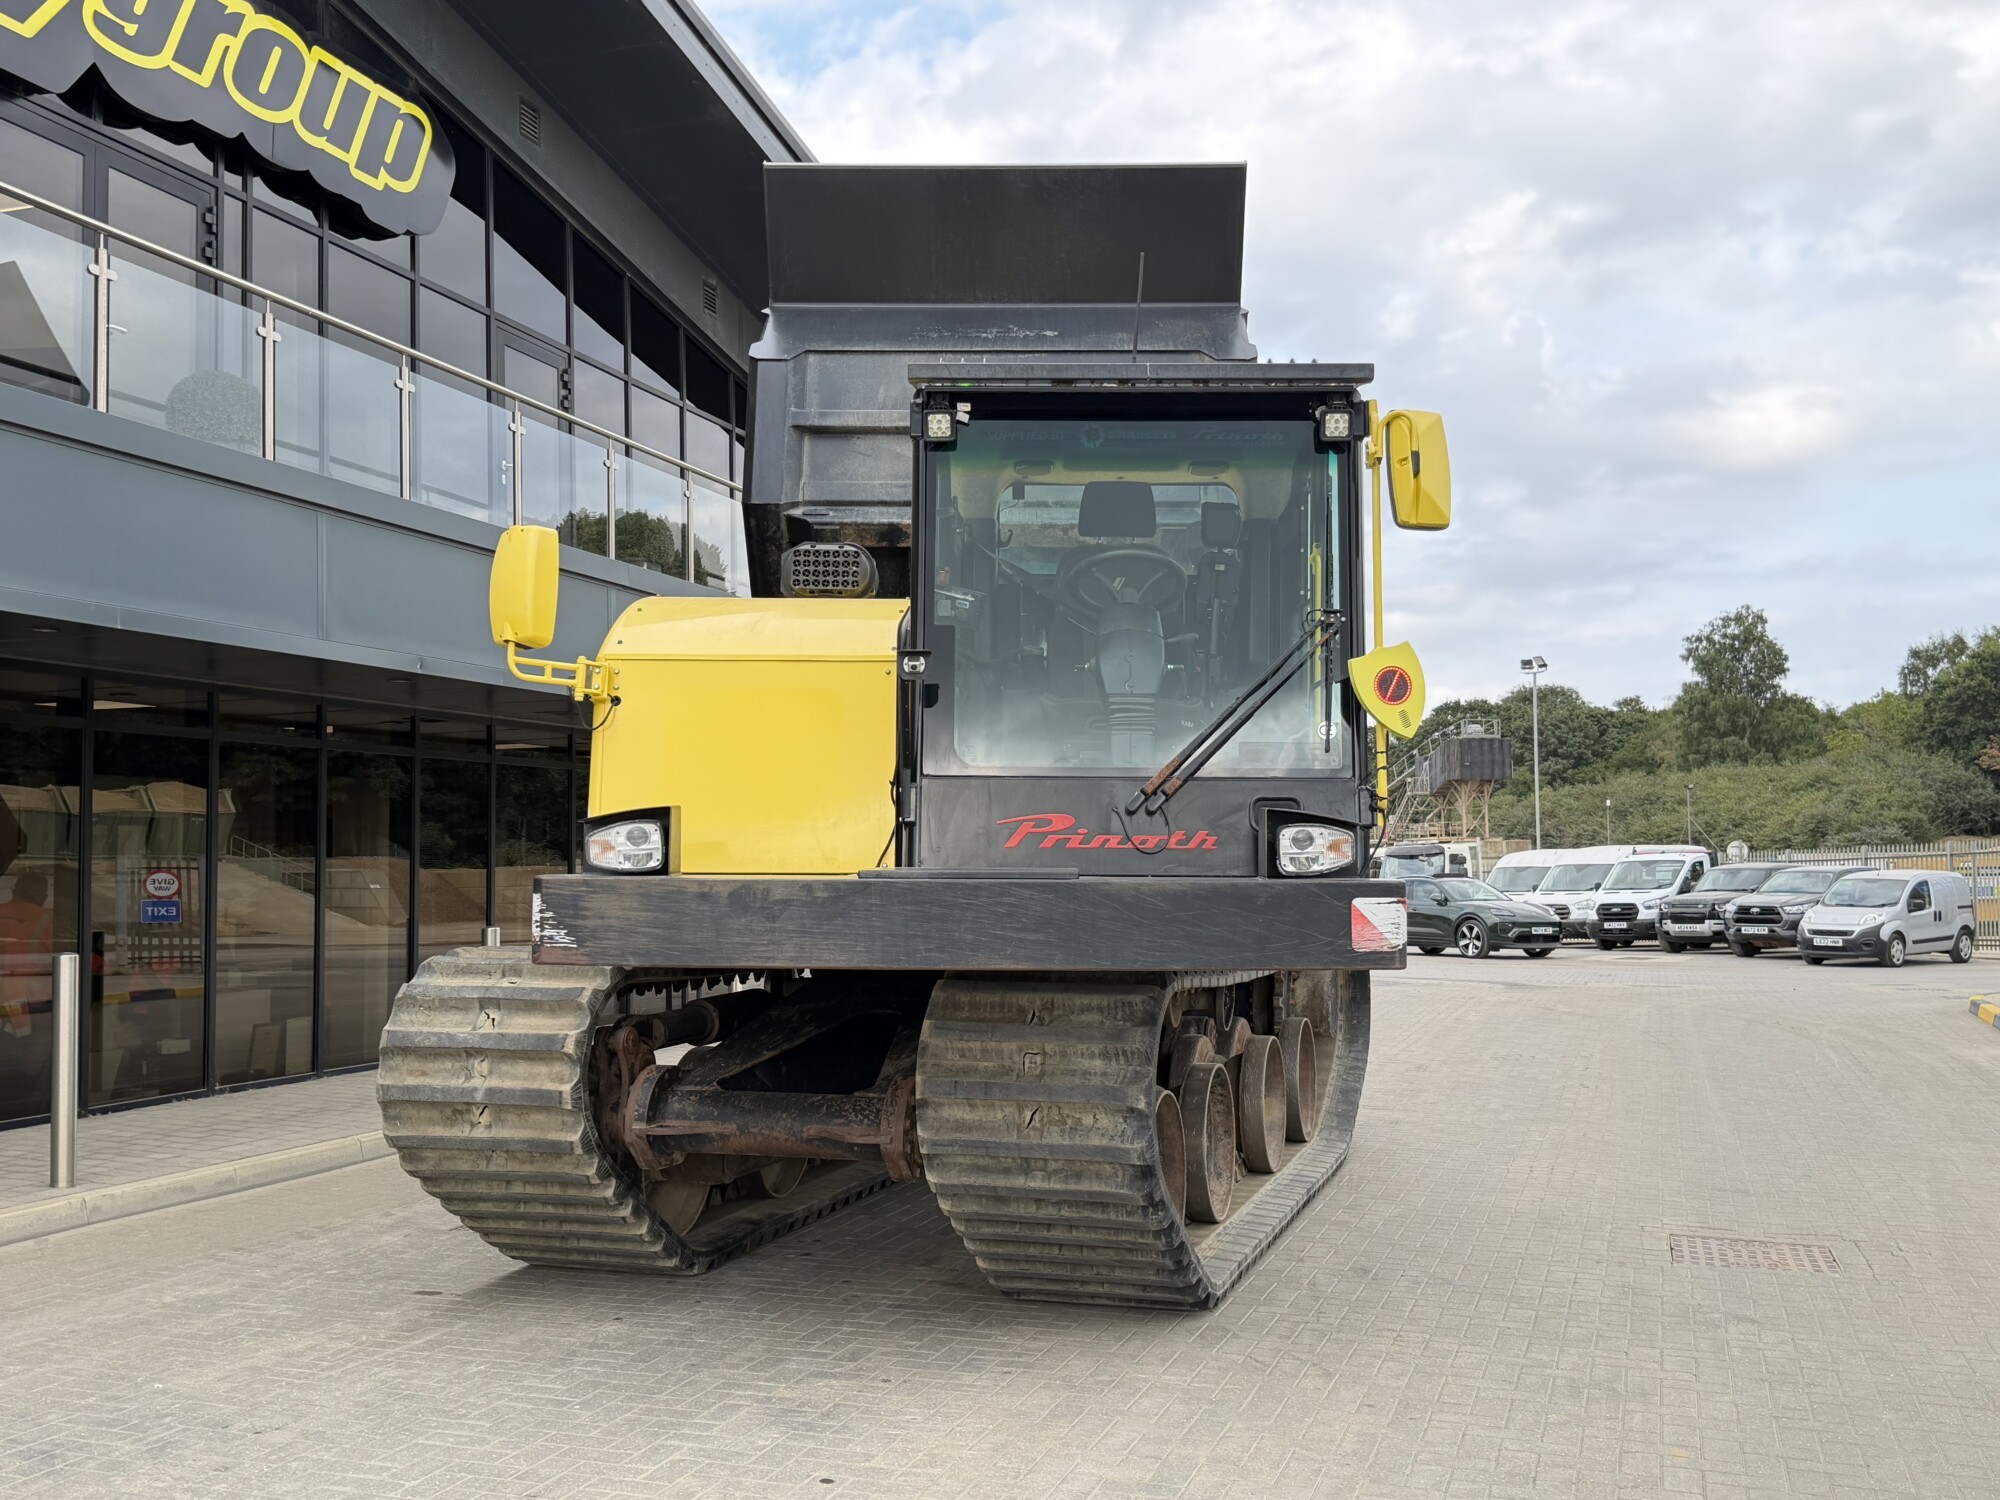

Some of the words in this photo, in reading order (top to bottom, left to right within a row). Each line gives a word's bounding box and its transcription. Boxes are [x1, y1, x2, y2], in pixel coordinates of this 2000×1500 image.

[0, 0, 435, 193] group
[985, 430, 1048, 441] SUPPLIED
[1050, 430, 1066, 440] BY
[996, 813, 1218, 849] Prinoth
